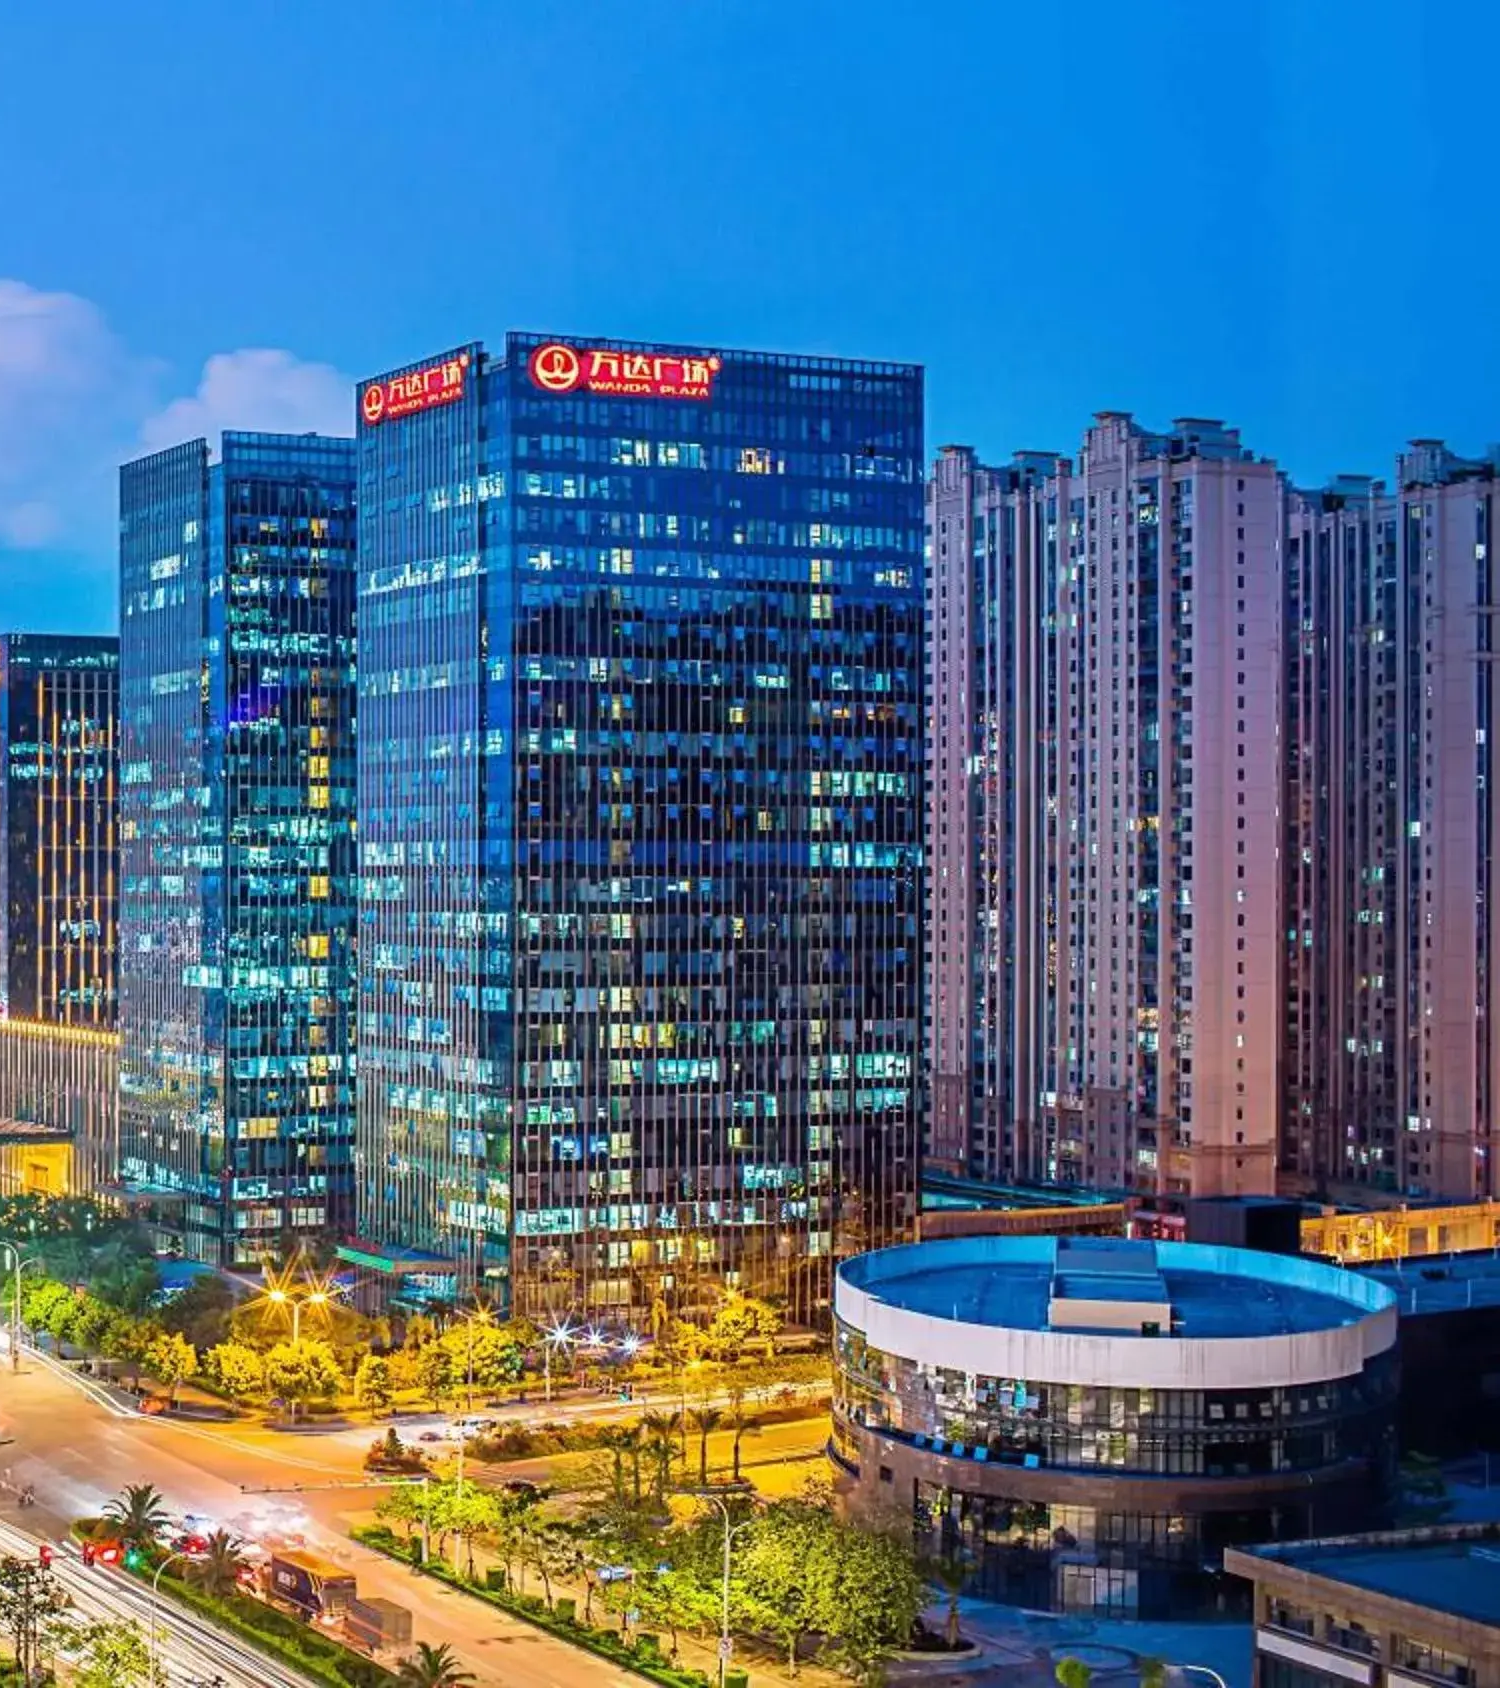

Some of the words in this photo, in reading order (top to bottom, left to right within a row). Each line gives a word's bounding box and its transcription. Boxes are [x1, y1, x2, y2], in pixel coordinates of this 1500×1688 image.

[388, 361, 461, 402] 万达广场
[589, 351, 709, 384] 万达广场
[588, 381, 651, 394] WANDA
[659, 385, 709, 397] PLAZA
